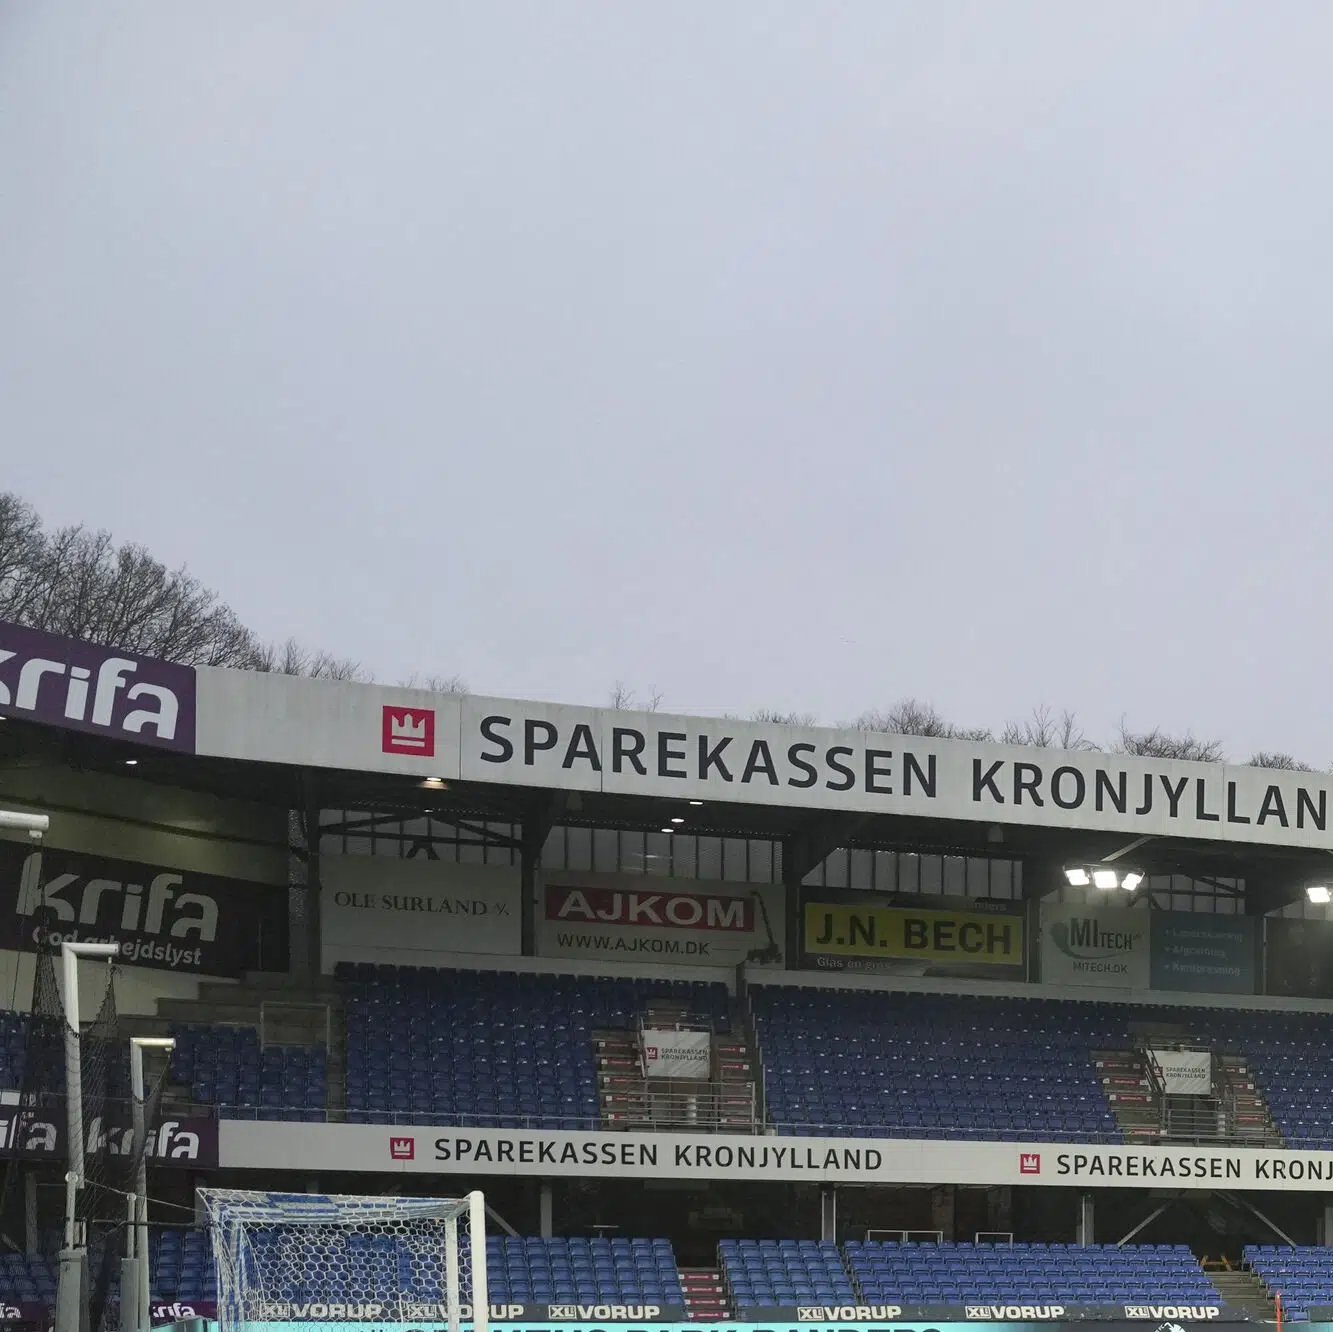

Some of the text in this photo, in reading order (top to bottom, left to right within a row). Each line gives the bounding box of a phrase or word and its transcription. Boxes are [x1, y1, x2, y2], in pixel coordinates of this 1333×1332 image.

[479, 715, 937, 799] SPAREKASSEN
[16, 851, 219, 942] krifa
[334, 891, 376, 908] OLE
[381, 894, 488, 915] SURLAND
[558, 890, 745, 928] AJKOM
[557, 932, 711, 955] WWW.AJKOM.DK
[816, 913, 1012, 954] J.N. BECH
[816, 956, 844, 968] Glas
[434, 1137, 883, 1171] SPAREKASSEN KRONJYLLAND
[1057, 1154, 1242, 1179] SPAREKASSEN
[293, 1304, 382, 1319] VORUP
[439, 1304, 523, 1319] VOUP
[577, 1304, 660, 1319] VORUP
[824, 1305, 902, 1320] VORUP
[991, 1305, 1064, 1318] VORUP
[1150, 1305, 1220, 1319] VORUP
